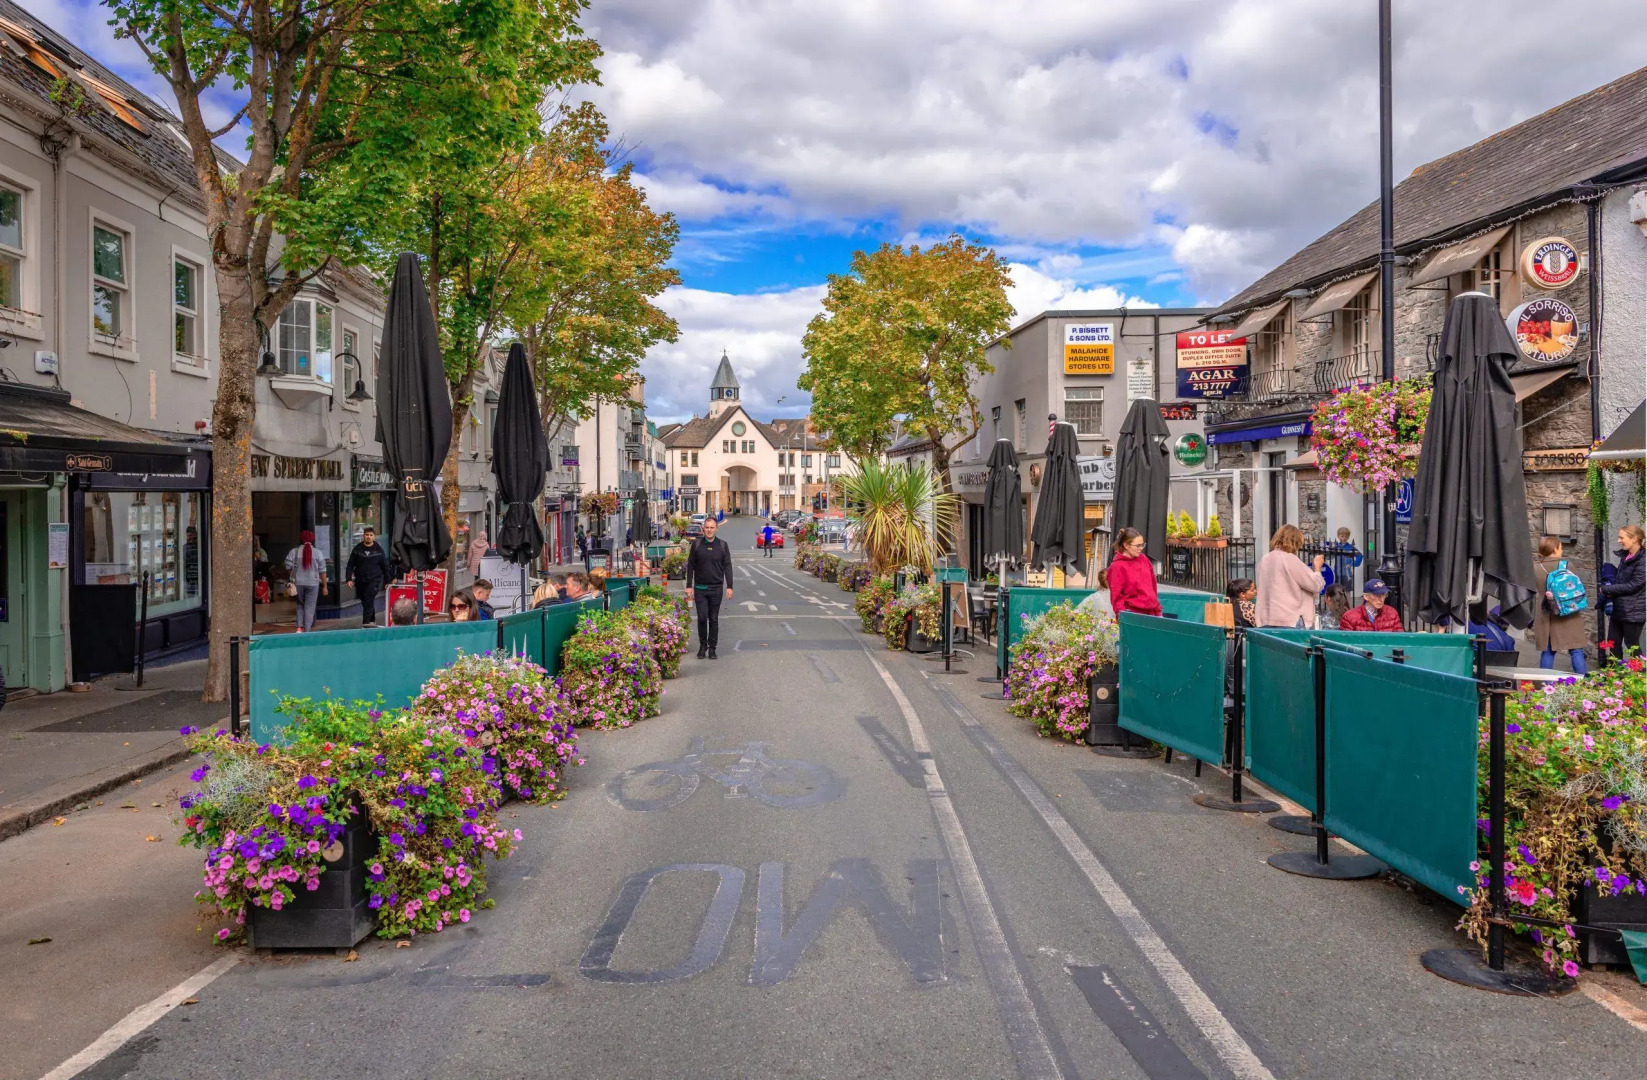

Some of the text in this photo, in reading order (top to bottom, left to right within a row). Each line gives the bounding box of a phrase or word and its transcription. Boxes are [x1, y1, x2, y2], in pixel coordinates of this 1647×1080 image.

[1535, 243, 1574, 260] ERDINGER
[1520, 300, 1574, 322] IL SORRISO
[1189, 335, 1206, 345] TO
[1516, 332, 1577, 361] RESTAURANT
[1187, 369, 1237, 381] AGAR
[1192, 381, 1232, 391] 213 7777
[1281, 425, 1302, 435] GUINNESS
[250, 454, 270, 479] EW
[273, 455, 316, 480] STREET
[359, 469, 380, 483] CASTLE
